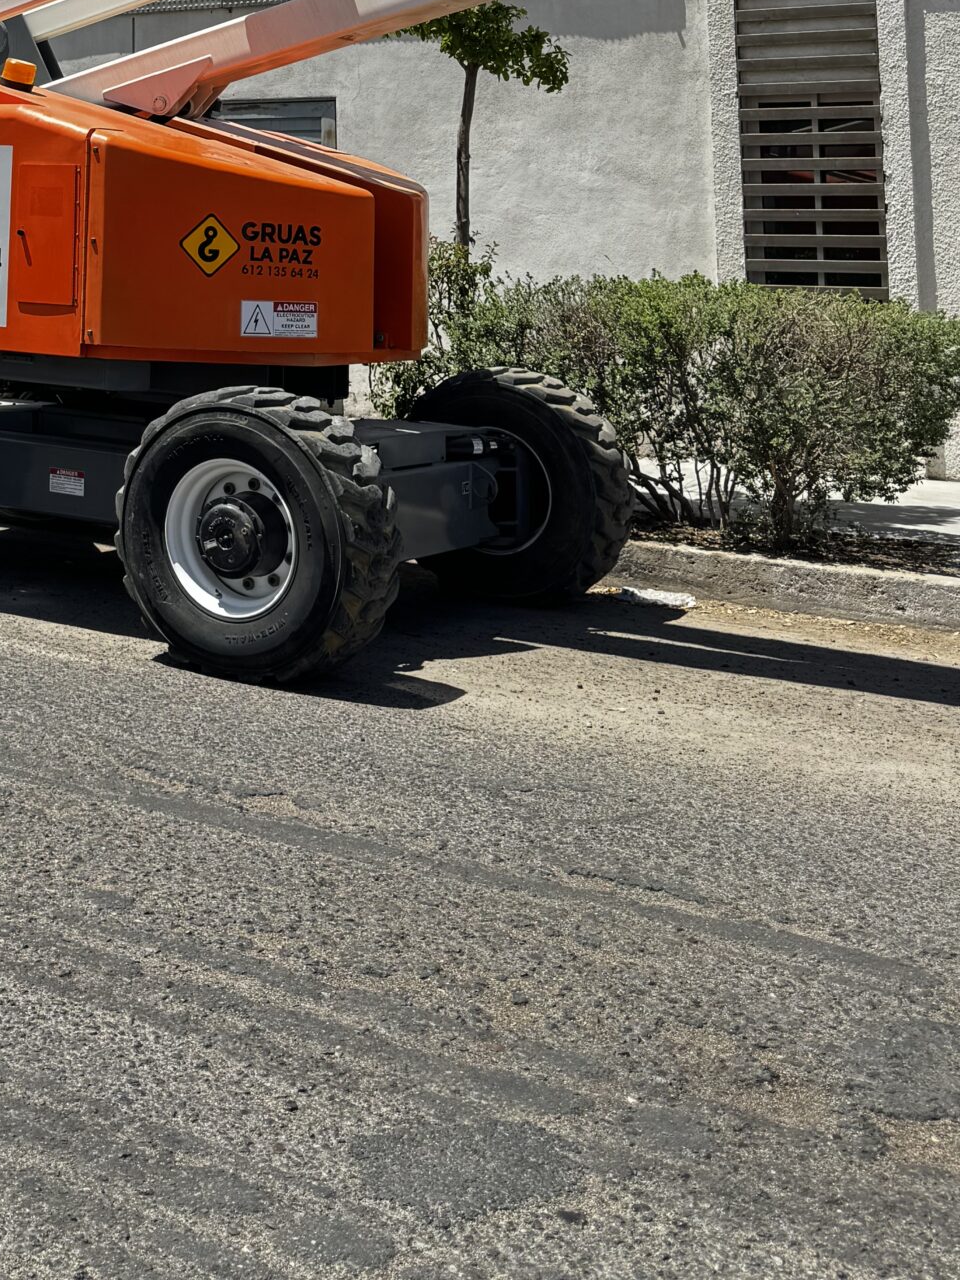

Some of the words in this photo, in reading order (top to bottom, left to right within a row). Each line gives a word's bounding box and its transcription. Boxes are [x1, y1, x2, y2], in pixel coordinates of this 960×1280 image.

[241, 221, 322, 247] GRUAS
[249, 246, 274, 263] LA
[279, 248, 313, 265] PAZ
[241, 265, 263, 276] 612
[268, 266, 287, 277] 135
[290, 268, 303, 278] 64
[307, 269, 319, 279] 24
[283, 303, 315, 312] DANGER
